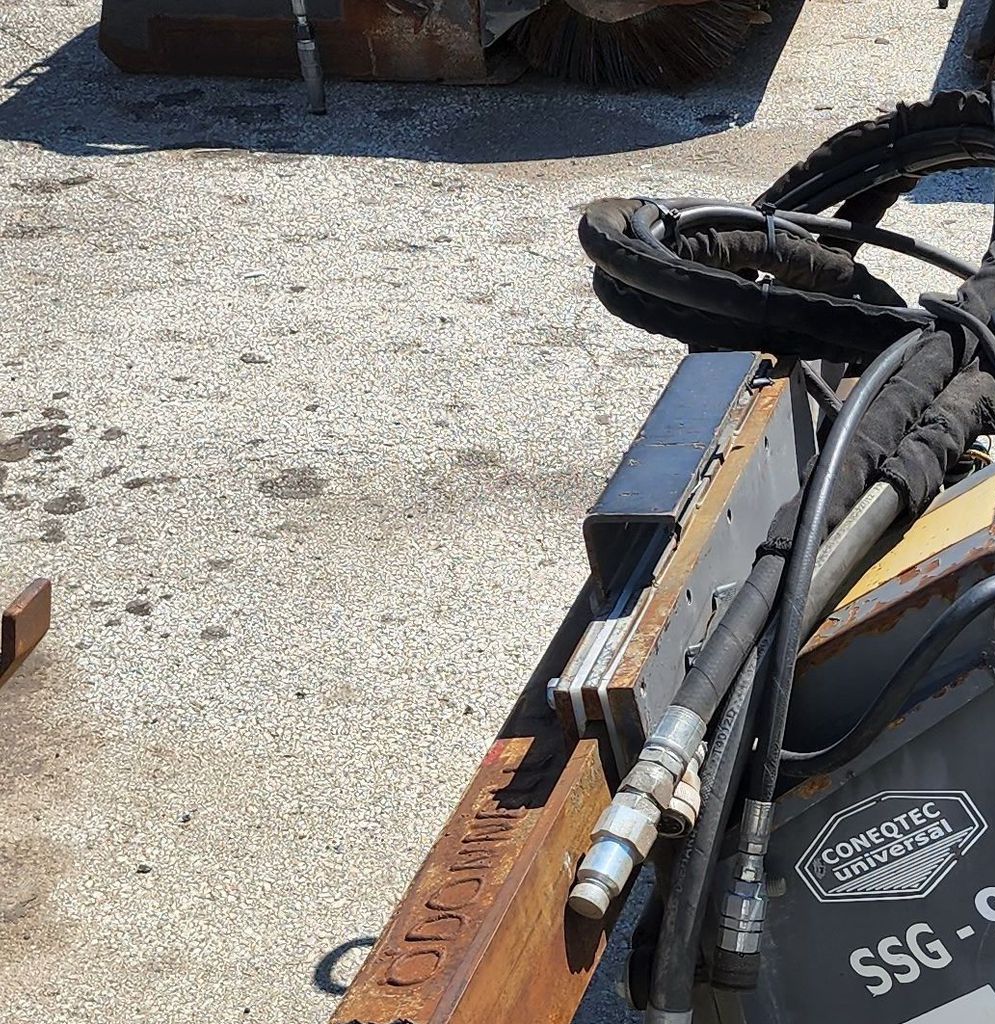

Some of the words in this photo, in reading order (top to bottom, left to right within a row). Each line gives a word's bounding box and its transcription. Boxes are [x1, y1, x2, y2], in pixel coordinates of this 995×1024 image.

[821, 801, 942, 865] CONEQTEC
[833, 818, 953, 882] universal
[849, 922, 953, 997] SSG
